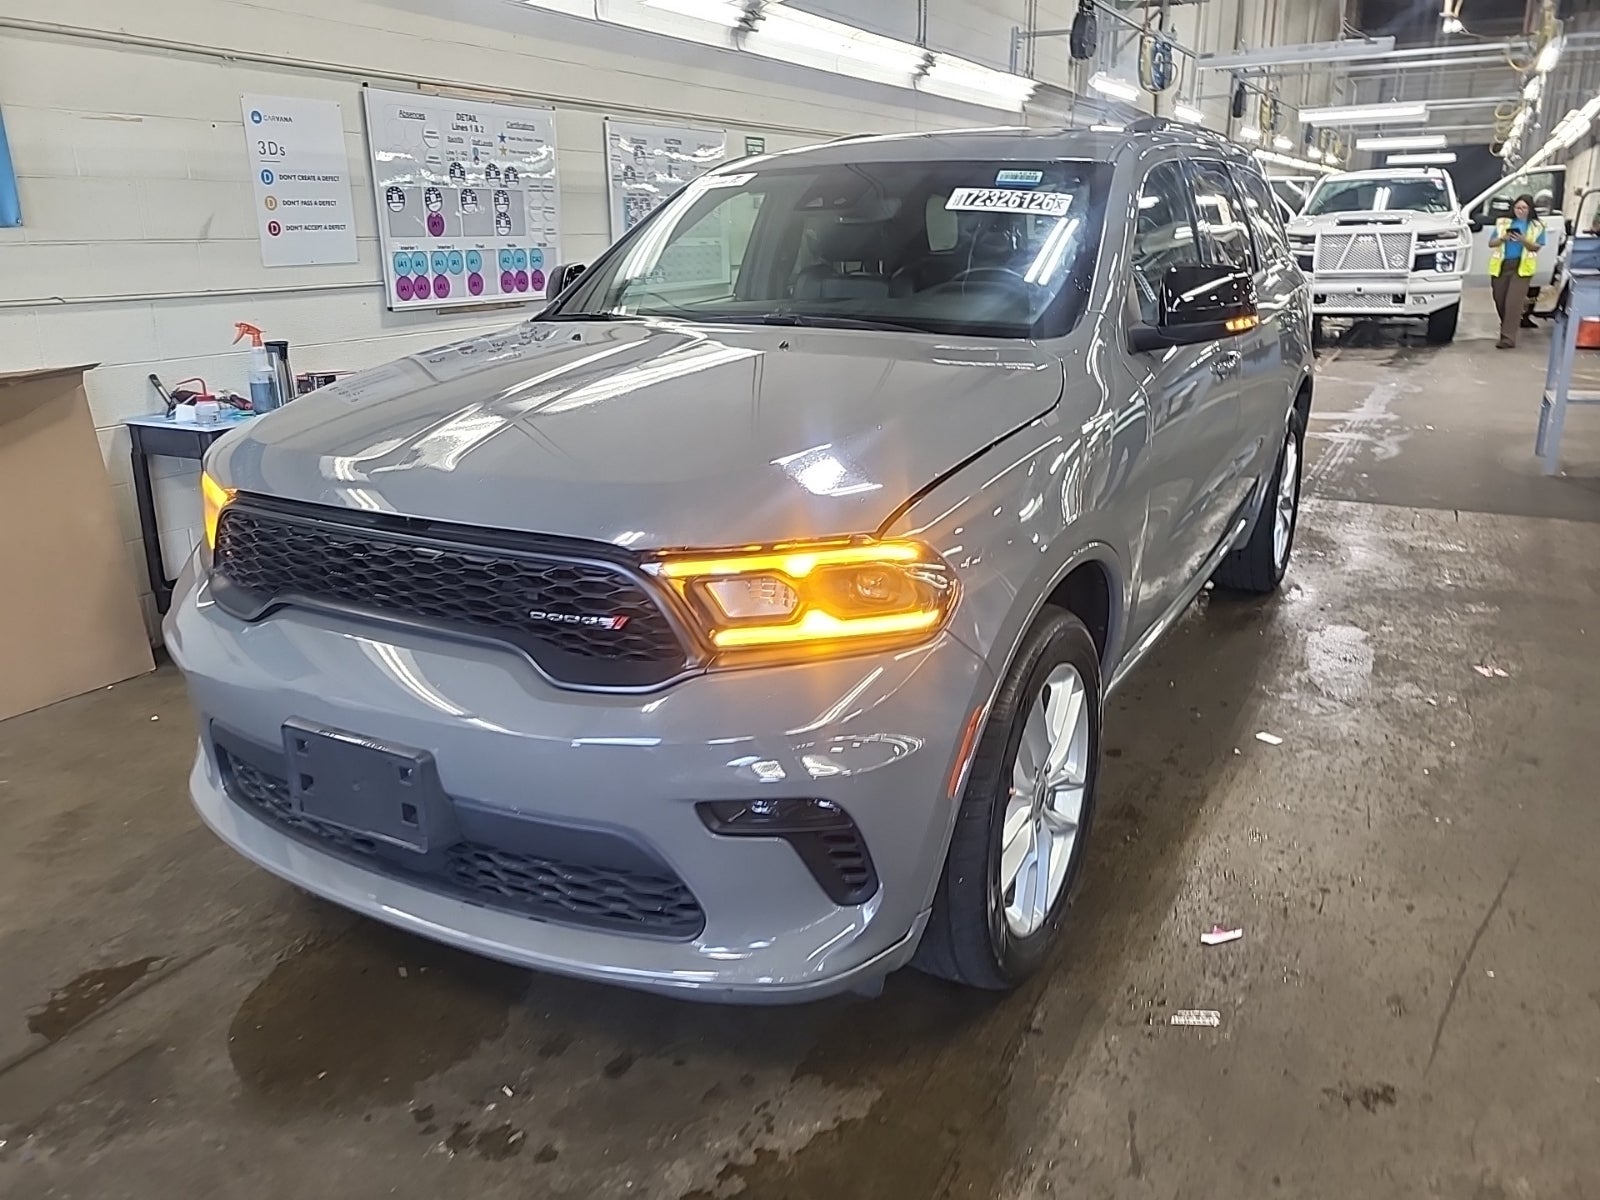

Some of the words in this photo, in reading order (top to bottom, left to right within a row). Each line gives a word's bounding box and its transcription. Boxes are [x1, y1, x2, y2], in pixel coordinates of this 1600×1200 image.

[456, 112, 478, 122] DETAIL
[452, 123, 468, 132] Lines
[257, 140, 286, 157] 3Ds
[962, 190, 1054, 211] 72326126
[530, 611, 616, 630] DODGE
